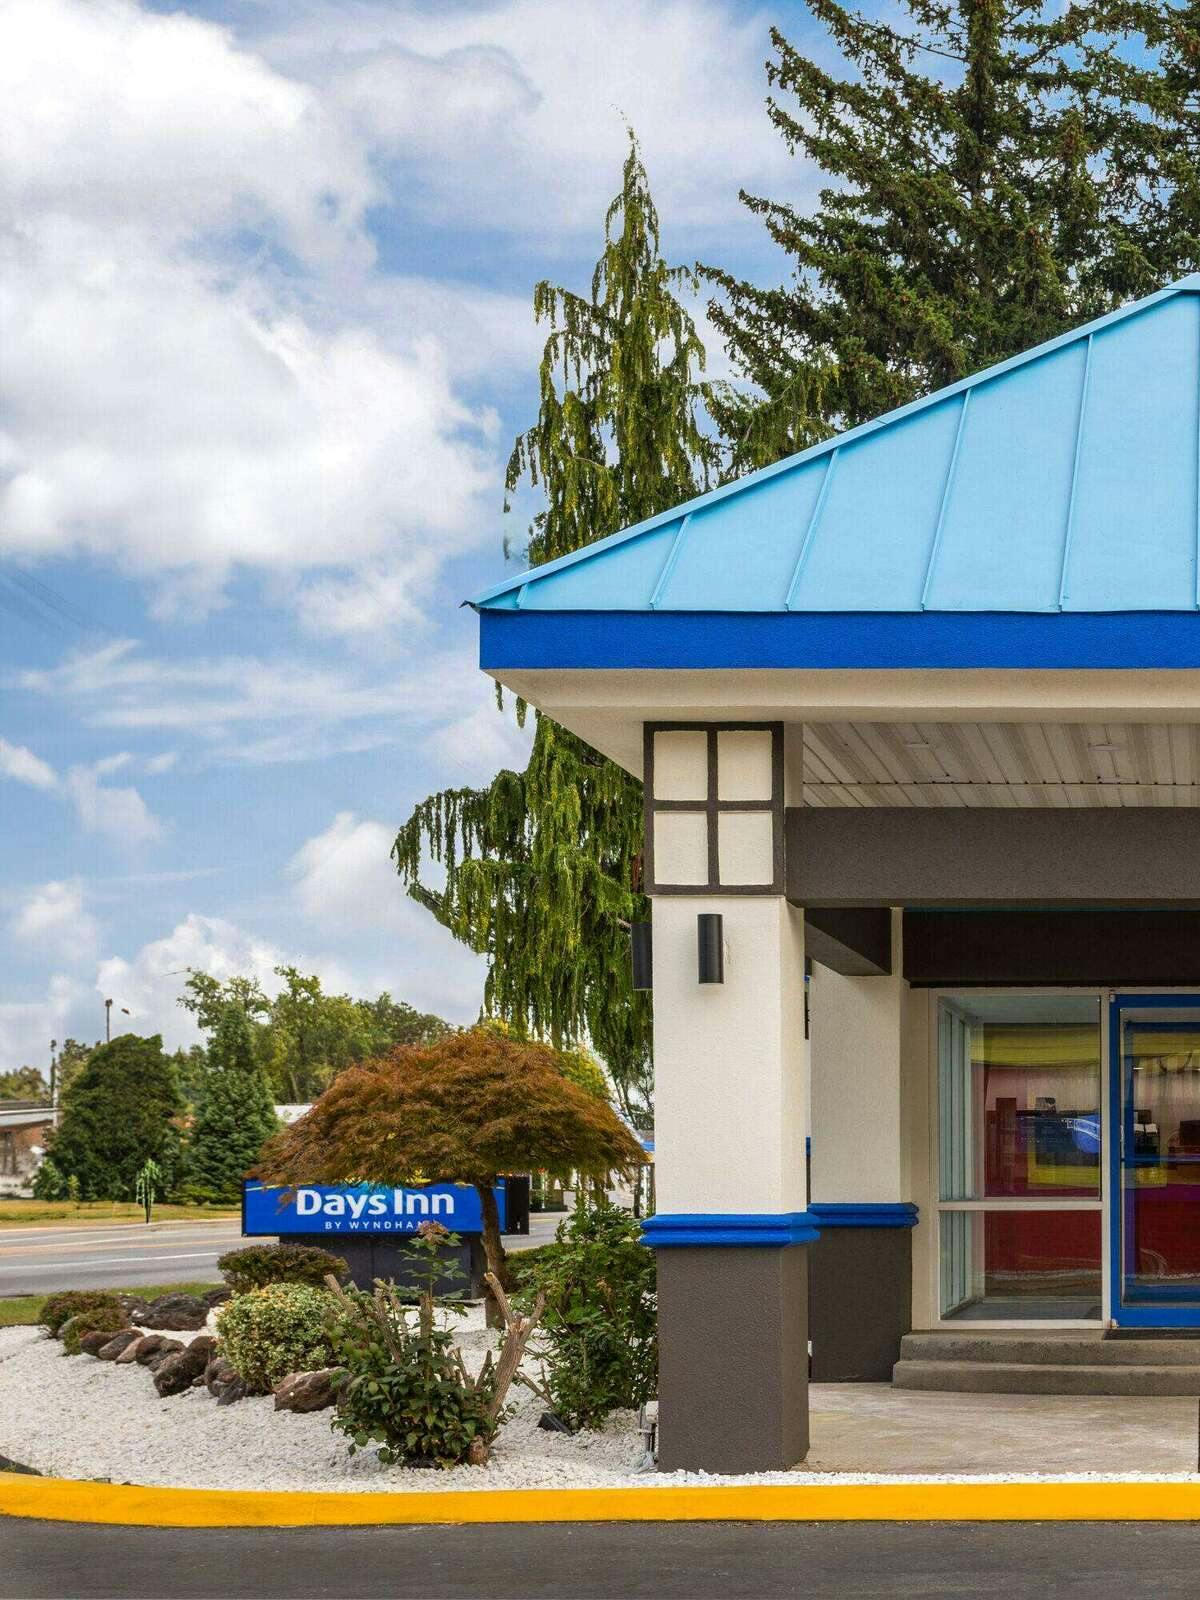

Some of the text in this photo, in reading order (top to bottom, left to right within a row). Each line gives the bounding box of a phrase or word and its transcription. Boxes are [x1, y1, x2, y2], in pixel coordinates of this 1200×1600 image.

[297, 1189, 454, 1219] Days Inn
[325, 1221, 426, 1230] BY WYNDHA
